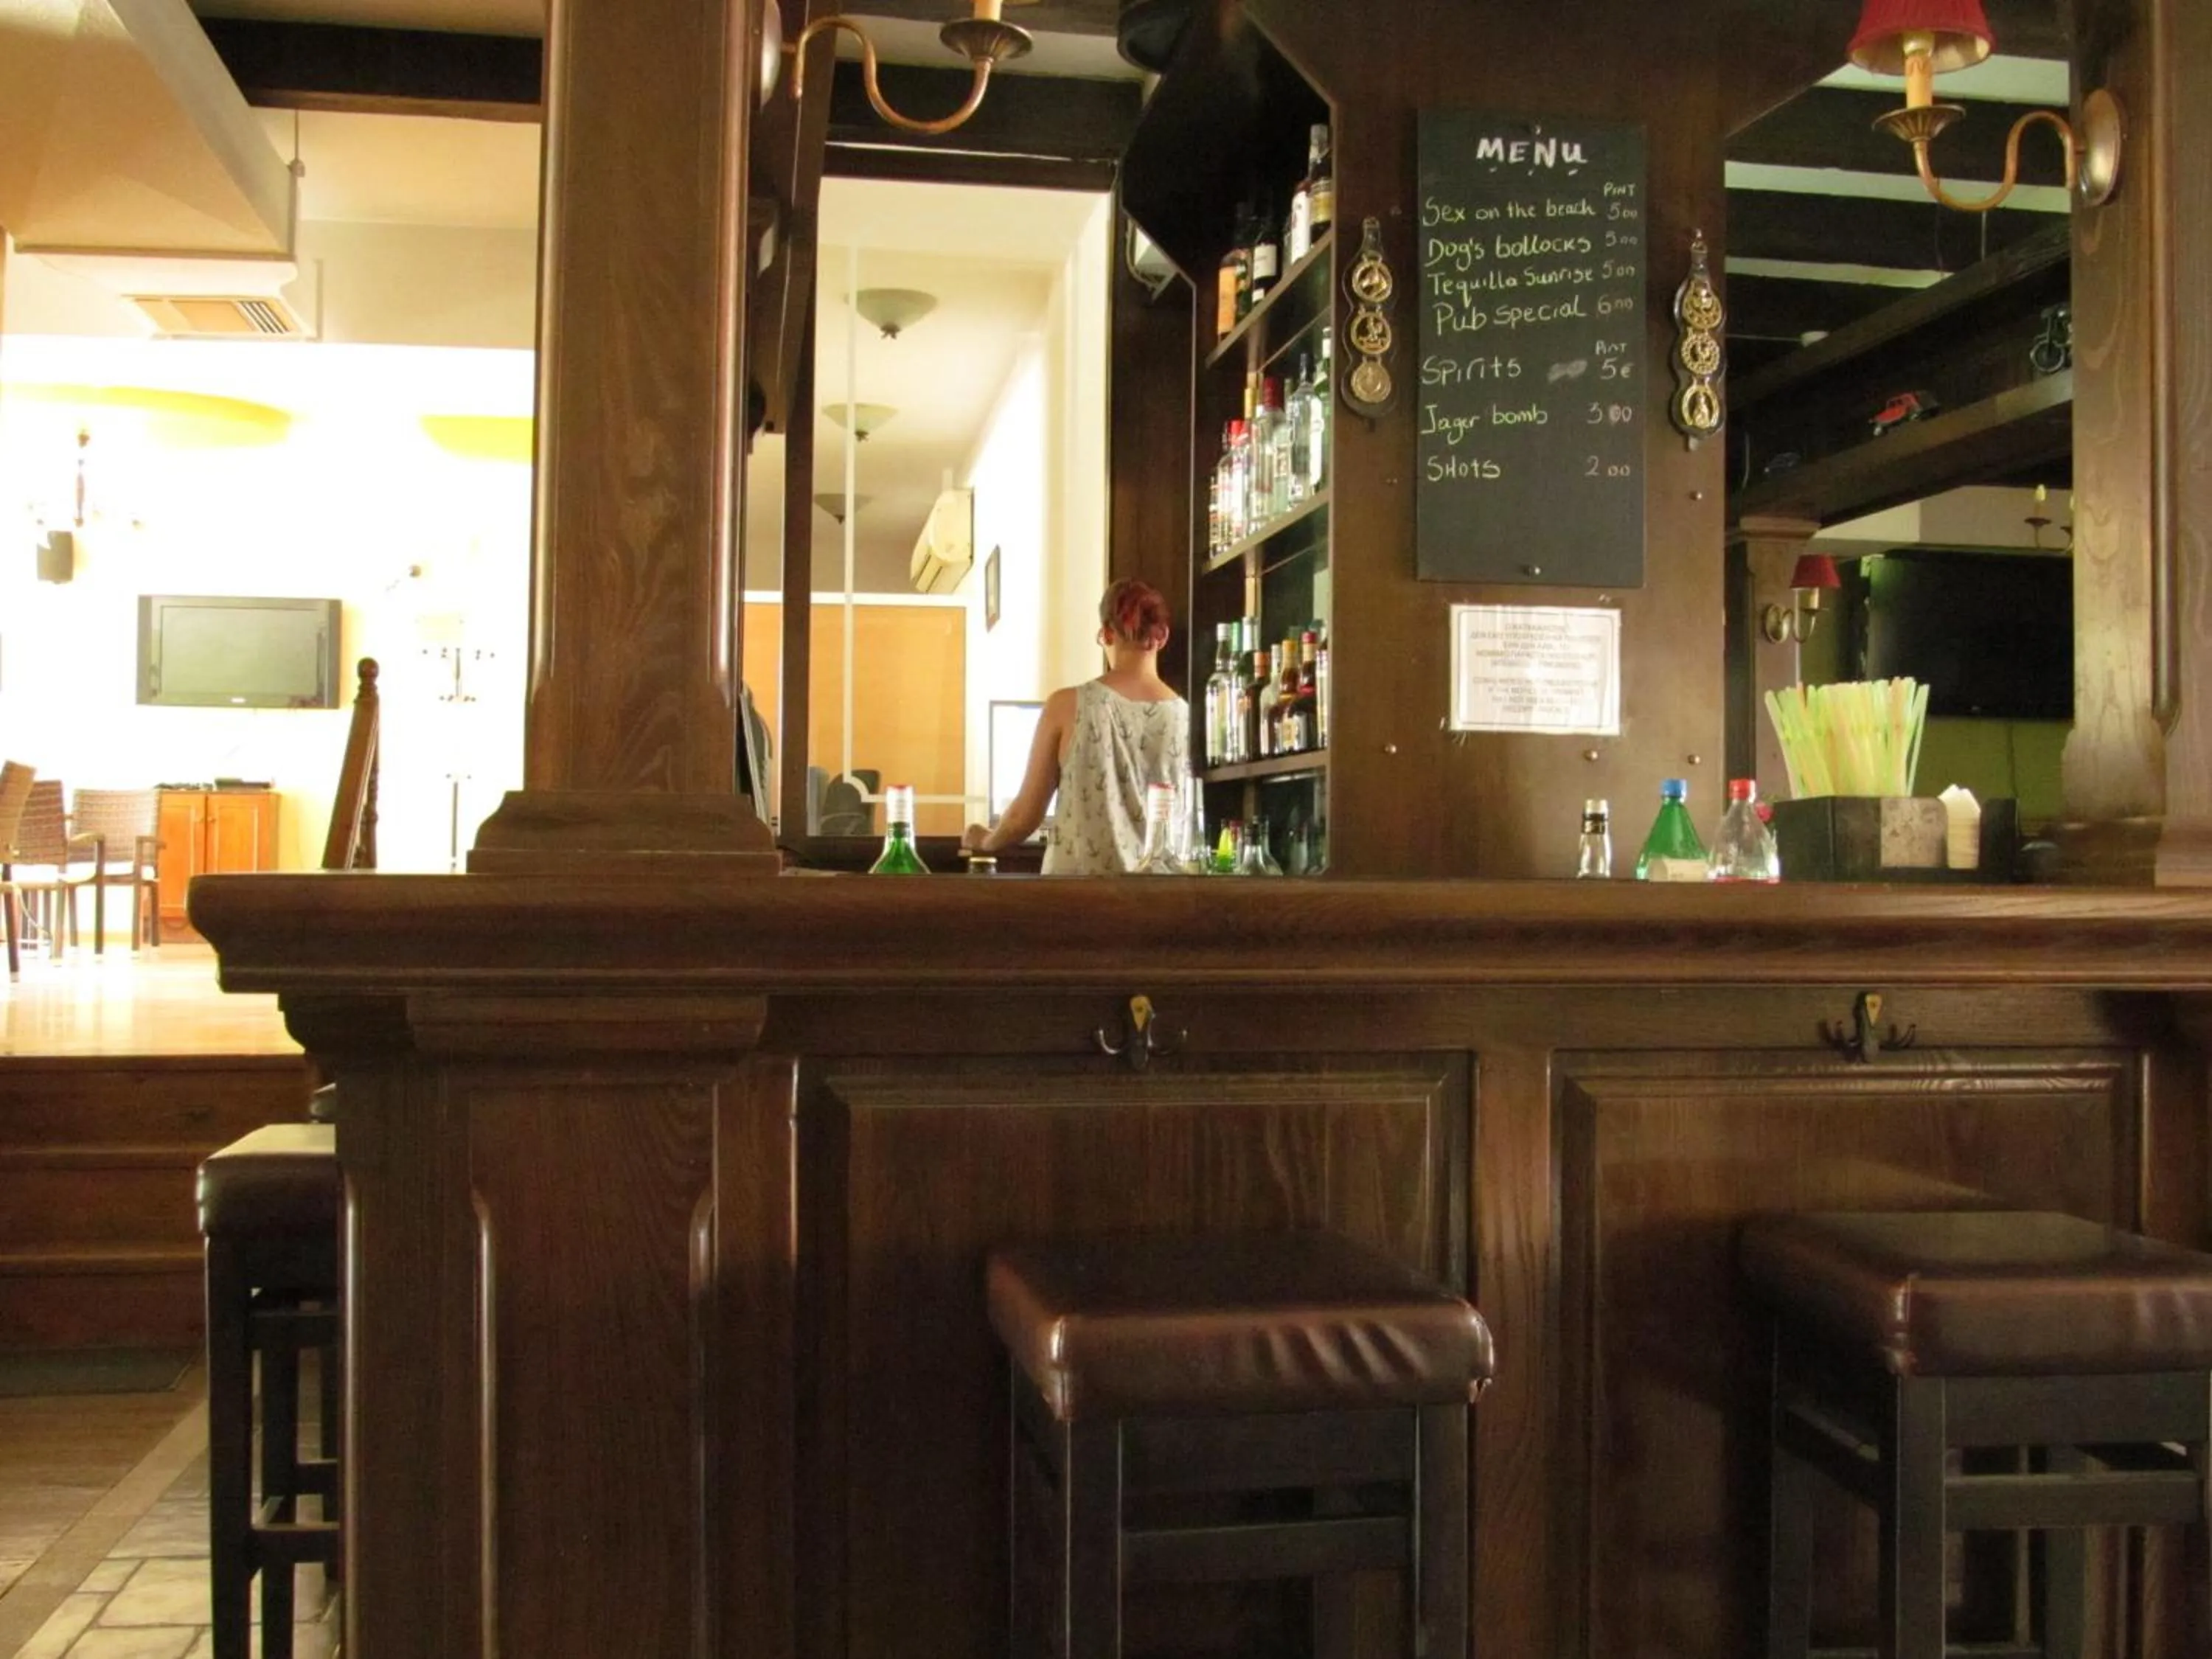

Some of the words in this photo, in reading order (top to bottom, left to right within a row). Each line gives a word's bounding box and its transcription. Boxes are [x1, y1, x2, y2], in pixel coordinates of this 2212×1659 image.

[1423, 196, 1466, 226] Sex
[1475, 206, 1500, 220] on
[1507, 201, 1536, 218] the
[1546, 198, 1596, 217] beach
[1425, 237, 1485, 271] Dog's
[1427, 271, 1518, 308] Tequilla
[1523, 266, 1593, 286] Sunrise
[1433, 302, 1487, 336] Pub
[1420, 403, 1481, 445] Jager
[1492, 403, 1548, 425] bomb
